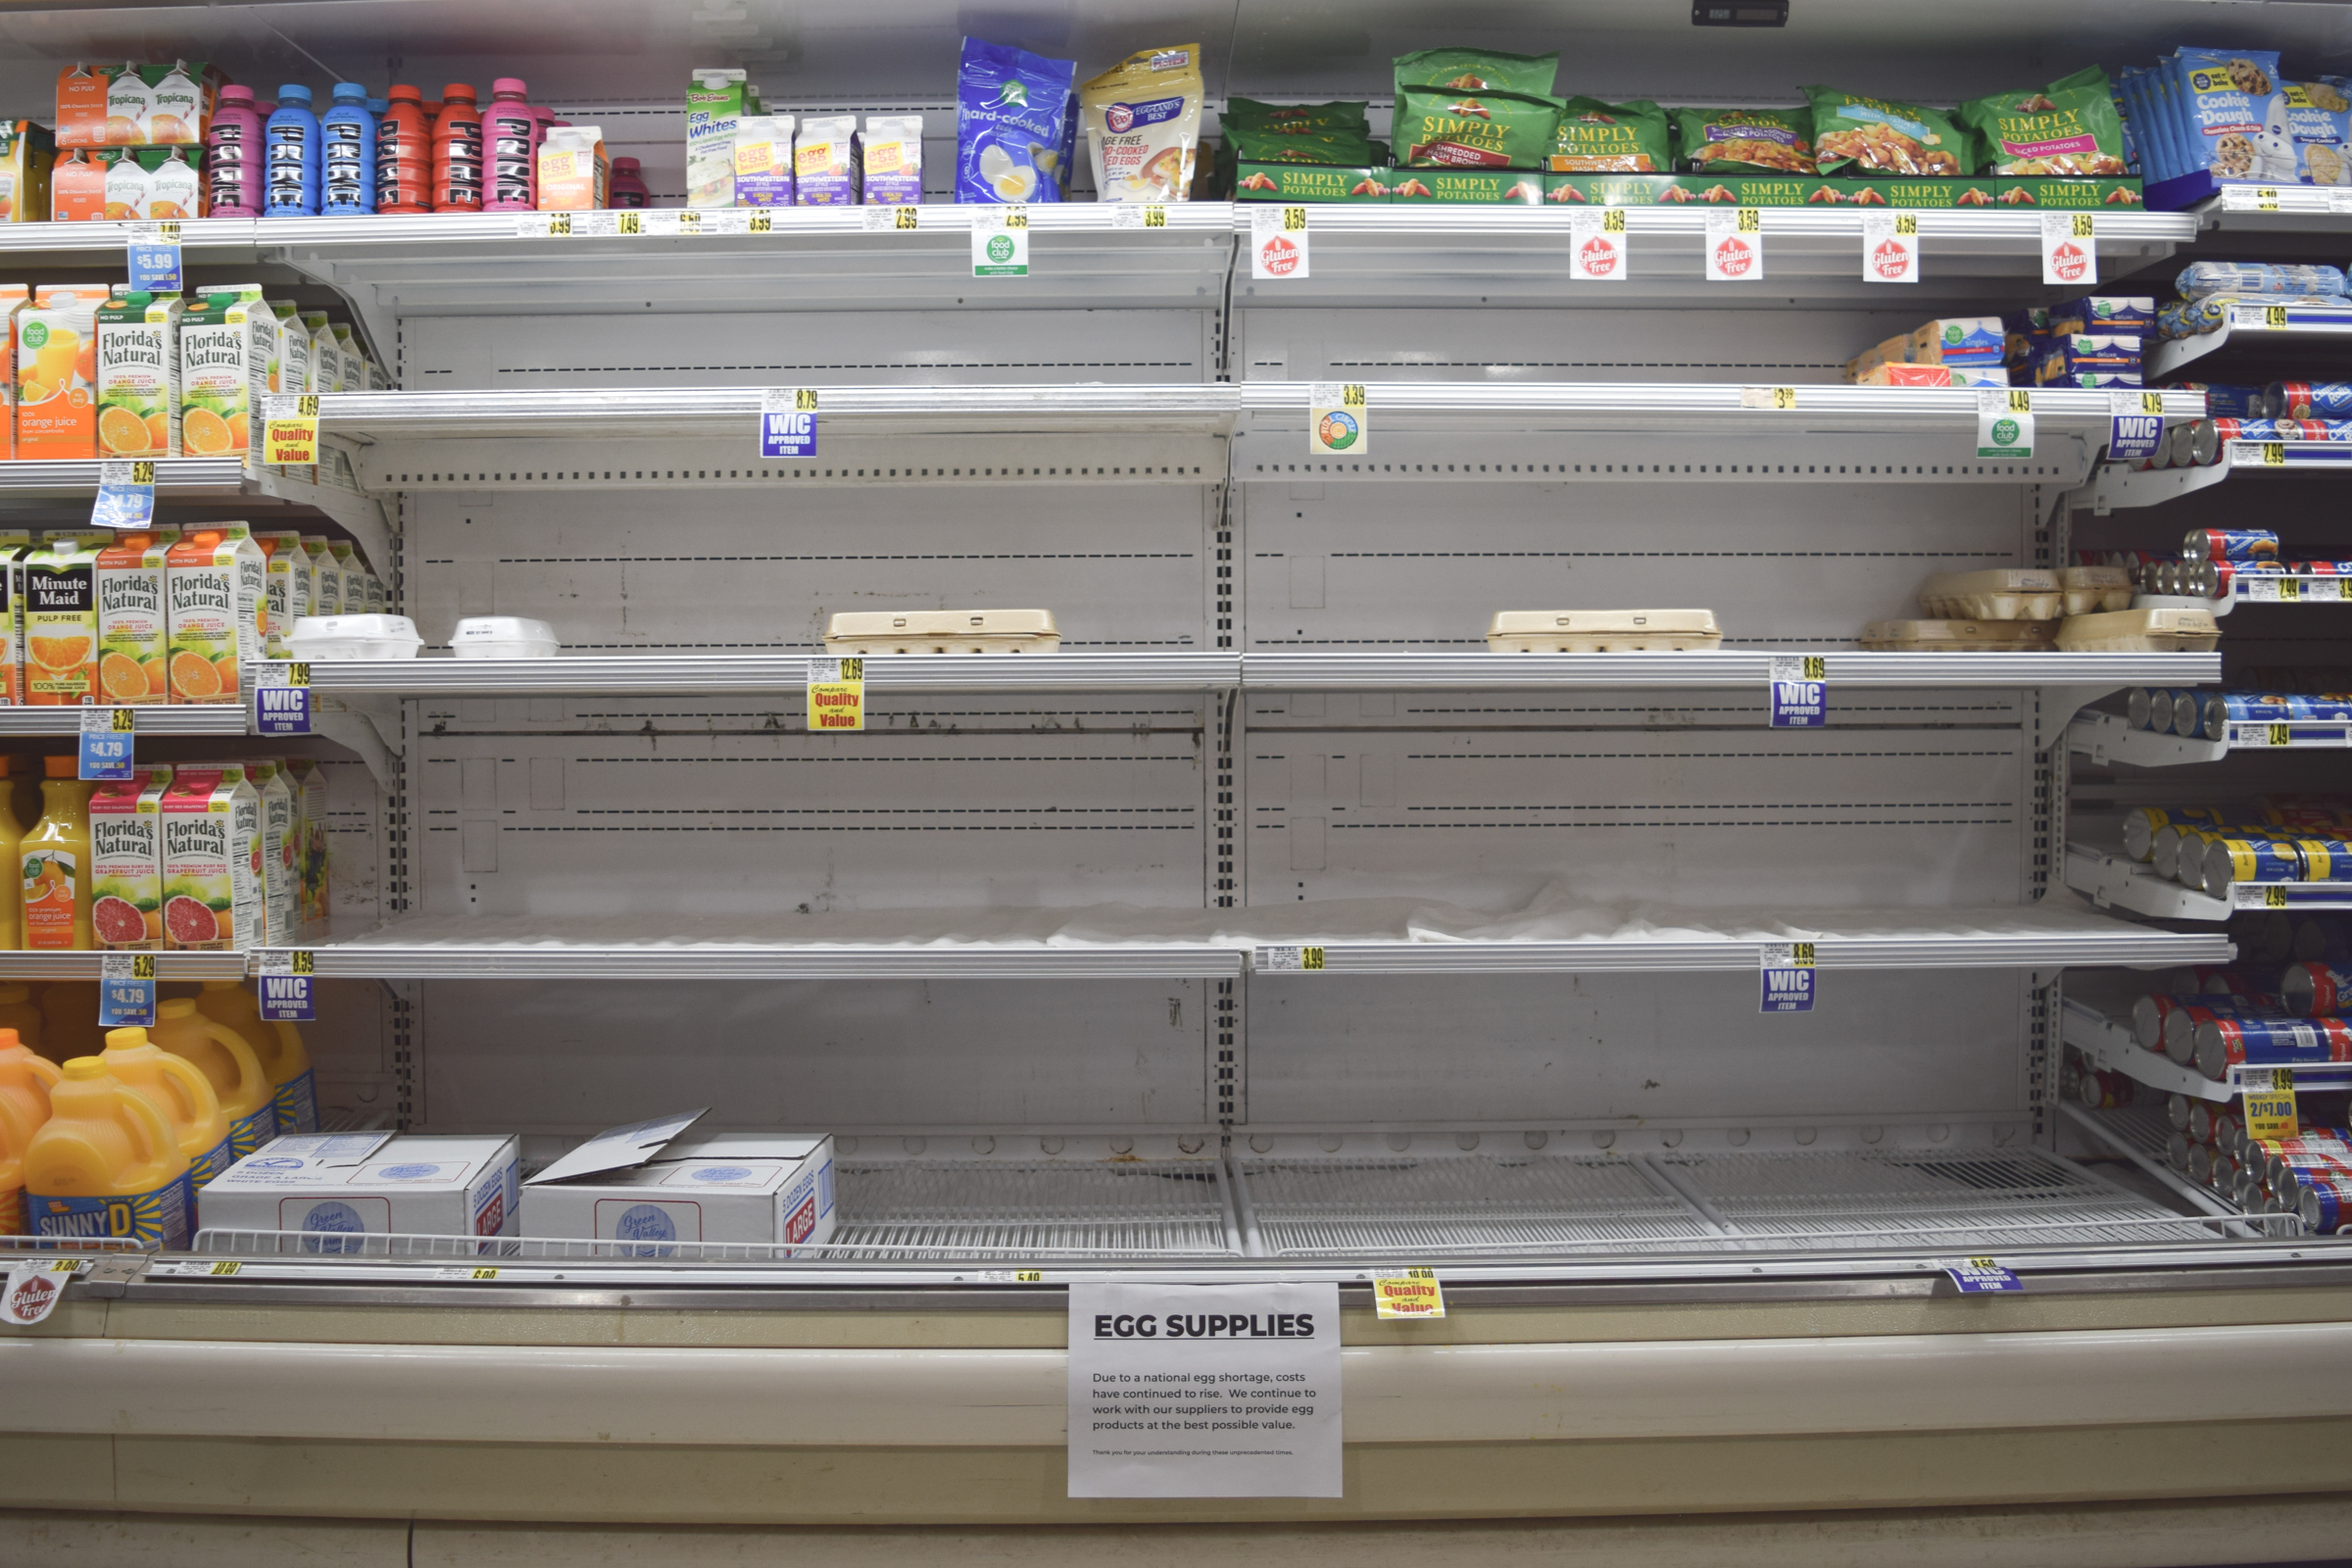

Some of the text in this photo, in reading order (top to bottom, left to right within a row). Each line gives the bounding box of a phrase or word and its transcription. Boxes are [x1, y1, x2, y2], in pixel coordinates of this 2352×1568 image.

[108, 94, 145, 106] Tropicana
[156, 93, 193, 105] Tropicana
[2197, 92, 2250, 111] Cookie
[690, 111, 710, 124] Egg
[964, 109, 1049, 137] hard-cooked
[1148, 112, 1167, 121] BEST
[1998, 108, 2079, 130] SIMPLY
[2202, 108, 2254, 125] Dough
[690, 119, 736, 139] Whites
[1422, 116, 1511, 139] SIMPLY
[1557, 126, 1638, 141] SIMPLY
[2002, 124, 2082, 143] POTATOES
[270, 125, 304, 208] PRIME
[326, 122, 361, 207] PRIME
[449, 121, 482, 203] PRIME
[496, 118, 531, 203] PRIME
[1283, 172, 1348, 187] SIMPLY
[1437, 177, 1500, 191] SIMPLY
[1740, 183, 1804, 194] SIMPLY
[1283, 185, 1347, 197] POTATOES
[1437, 190, 1499, 200] POTATOES
[1890, 186, 1952, 197] SIMPLY
[2039, 184, 2101, 196] SIMPLY
[1741, 196, 1803, 205] POTATOES
[1891, 198, 1952, 207] POTATOES
[896, 208, 917, 229] 2.99
[1146, 206, 1164, 226] 3.99
[1285, 208, 1305, 229] 3.59
[1603, 210, 1625, 230] 3.59
[1738, 210, 1759, 230] 3.59
[1895, 214, 1916, 233] 3.59
[2073, 216, 2092, 235] 3.59
[991, 240, 1009, 249] food
[137, 254, 172, 269] $5.99
[1260, 248, 1299, 266] Gluten
[1579, 248, 1617, 266] Gluten
[1714, 249, 1752, 266] Gluten
[1872, 251, 1909, 269] Gluten
[2050, 253, 2087, 270] Gluten
[1271, 262, 1293, 273] Free
[1590, 262, 1610, 273] Free
[1725, 262, 1746, 273] Free
[1883, 264, 1903, 276] Free
[2060, 266, 2082, 278] Free
[102, 330, 163, 350] Florida's
[103, 349, 161, 367] Natural
[797, 390, 817, 409] 8.79
[1344, 385, 1364, 405] 3.39
[2009, 391, 2030, 411] 4.49
[2142, 393, 2162, 413] 4.79
[298, 396, 318, 416] 4.69
[22, 417, 76, 428] orange juice
[769, 414, 810, 434] WIC
[1996, 423, 2016, 432] food
[2119, 417, 2158, 438] WIC
[271, 428, 314, 443] Quality
[768, 435, 810, 444] APPROVED
[2116, 439, 2155, 448] APPROVED
[275, 449, 310, 462] Value
[779, 446, 799, 455] ITEM
[2264, 443, 2283, 464] 2.99
[133, 463, 154, 482] 5.29
[31, 576, 88, 590] Minute
[102, 575, 159, 595] Florida's
[2279, 579, 2298, 599] 2.99
[39, 591, 79, 605] Maid
[102, 593, 158, 612] Natural
[289, 663, 310, 685] 7.99
[841, 659, 862, 679] 12.69
[1804, 657, 1825, 678] 8.69
[263, 690, 303, 710] WIC
[815, 693, 858, 707] Quality
[1779, 684, 1820, 705] WIC
[263, 711, 304, 721] APPROVED
[1779, 706, 1820, 714] APPROVED
[113, 710, 133, 730] 5.29
[274, 722, 293, 731] ITEM
[819, 714, 855, 726] Value
[2270, 724, 2287, 745] 2.49
[90, 742, 122, 757] $4.79
[94, 820, 153, 840] Florida's
[95, 838, 152, 858] Natural
[2265, 886, 2286, 906] 2.99
[134, 956, 155, 977] 5.29
[293, 952, 314, 972] 8.59
[1303, 948, 1323, 969] 3.99
[267, 979, 307, 999] WIC
[1768, 970, 1809, 991] WIC
[111, 989, 145, 1004] $4.79
[267, 1000, 307, 1009] APPROVED
[278, 1009, 297, 1018] ITEM
[2273, 1069, 2292, 1090] 3.99
[2250, 1102, 2292, 1117] 2/$7.00
[624, 1215, 656, 1233] Green
[1384, 1286, 1435, 1297] Quality
[21, 1304, 46, 1317] Free
[1095, 1313, 1315, 1338] EGG SUPPLIES
[1093, 1373, 1116, 1383] Due
[1119, 1374, 1131, 1383] to
[1144, 1373, 1191, 1383] national
[1194, 1375, 1216, 1385] egg
[1219, 1373, 1273, 1384] shortage,
[1276, 1373, 1305, 1383] costs
[1093, 1389, 1317, 1398] have continued to rise. We continue to
[1093, 1404, 1122, 1414] work
[1124, 1404, 1151, 1414] with
[1176, 1404, 1228, 1416] suppliers
[1231, 1405, 1243, 1414] to
[1246, 1404, 1289, 1416] provide
[1292, 1406, 1314, 1416] egg
[1093, 1420, 1296, 1431] products at the best possible value.
